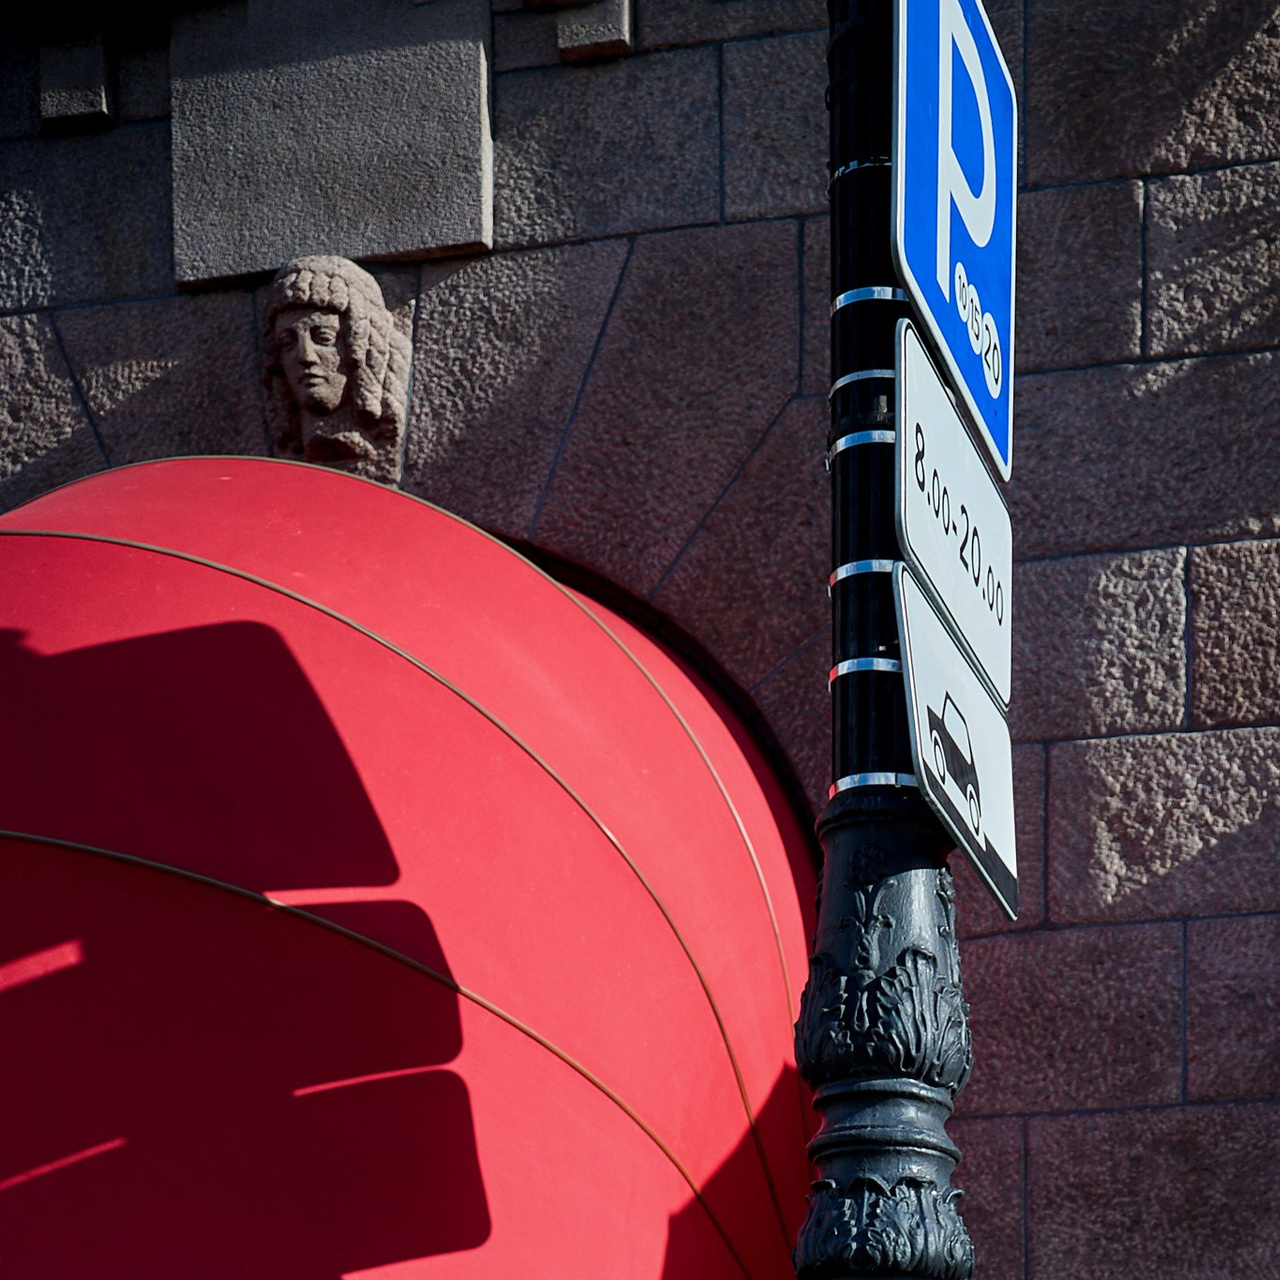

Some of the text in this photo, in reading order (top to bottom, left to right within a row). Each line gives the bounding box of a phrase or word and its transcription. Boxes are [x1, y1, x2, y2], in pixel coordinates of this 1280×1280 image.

[936, 0, 996, 303] P
[958, 274, 1000, 386] 10 15 20
